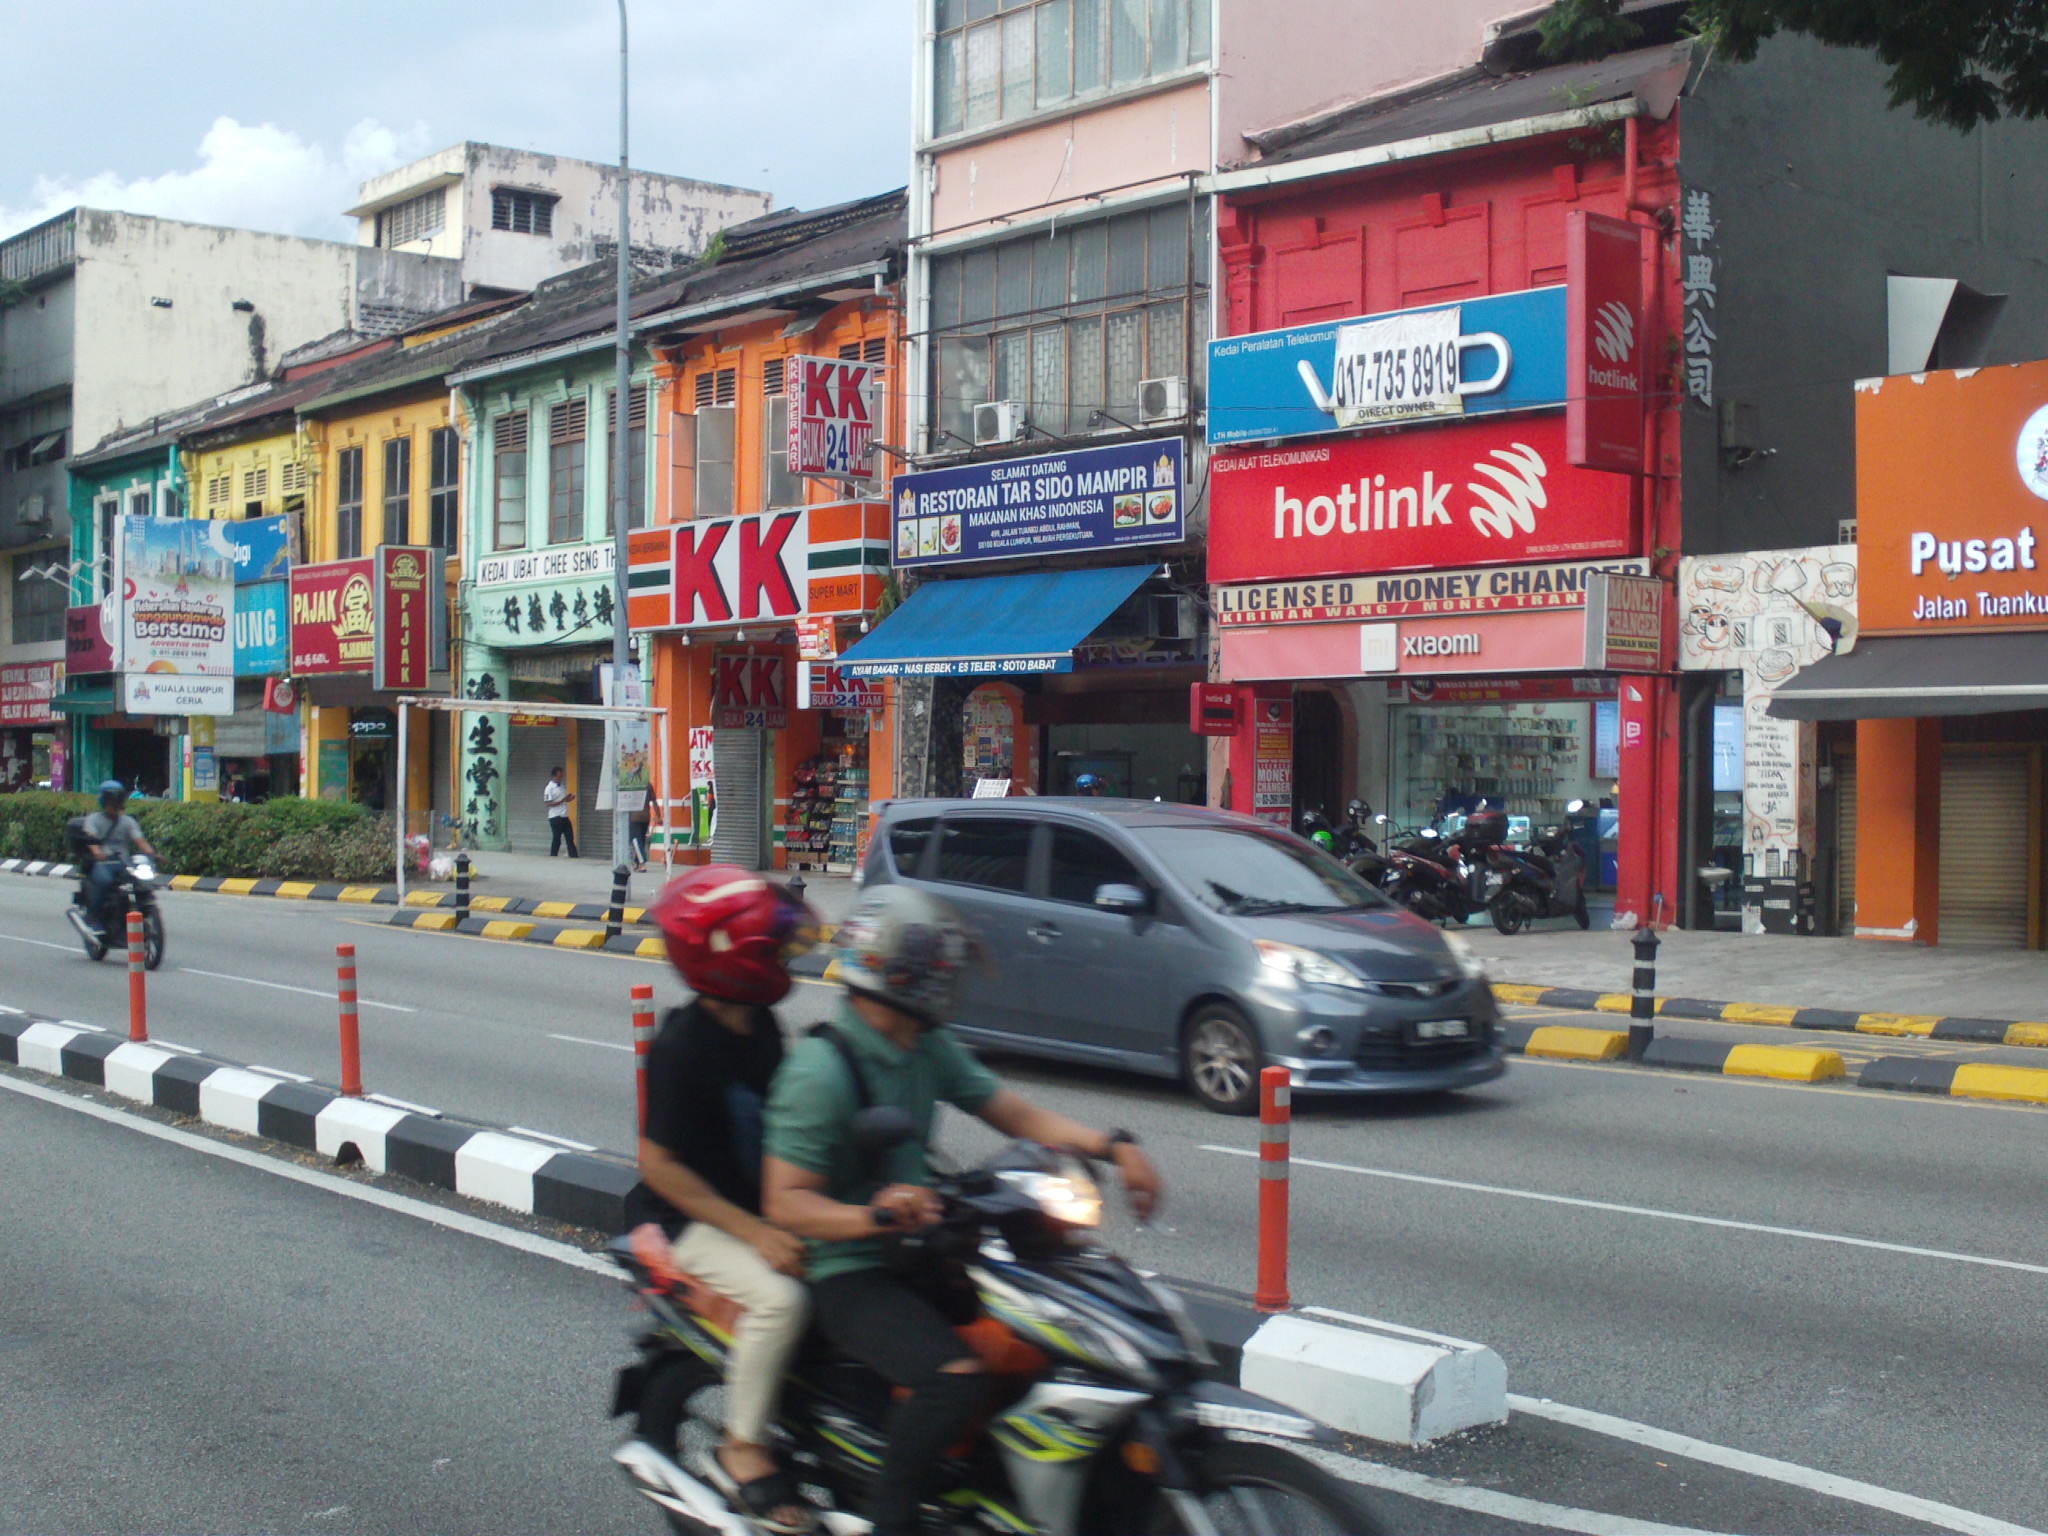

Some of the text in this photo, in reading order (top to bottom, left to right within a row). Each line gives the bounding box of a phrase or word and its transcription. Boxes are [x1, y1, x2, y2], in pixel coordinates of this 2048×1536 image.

[1213, 342, 1239, 358] Kedai
[1241, 338, 1284, 353] Peralatan
[790, 360, 799, 379] KK
[1412, 340, 1457, 398] 8919
[1588, 363, 1639, 392] hotlink
[806, 360, 868, 421] KK
[790, 383, 799, 429] SUPER
[1358, 401, 1436, 419] DIRECT OWNER
[790, 433, 799, 471] MART
[802, 421, 825, 468] BUKA
[826, 423, 849, 472] 24
[1213, 448, 1330, 473] KEDAI ALAT TELEKOMUNIKASI
[991, 459, 1067, 481] SELAMAT DATANG
[920, 465, 1148, 515] RESTORAN TAR SIDO MAMPIR
[969, 498, 1104, 528] MAKANAN KHAS INDONESIA
[1275, 471, 1453, 539] hotlink
[1911, 525, 2036, 575] Pusat
[482, 558, 509, 583] KEDAI
[513, 557, 539, 579] UBAT
[543, 553, 568, 576] CHEE
[573, 549, 599, 572] SENG
[675, 510, 802, 625] KK
[809, 583, 859, 599] SUPER MART
[1223, 582, 1354, 612] LICENSED
[1377, 574, 1482, 603] MONEY
[1608, 577, 1660, 613] MONEY
[1913, 590, 2048, 620] Jalan Tuanku
[293, 589, 338, 625] PAJAK
[1222, 608, 1313, 623] KIRIMAN
[1326, 604, 1388, 617] WANG
[1422, 597, 1502, 612] MONEY
[135, 621, 225, 642] Bersama
[400, 592, 411, 683] PAJAK
[1607, 610, 1659, 637] CHANGER
[720, 657, 780, 707] KK
[852, 659, 1057, 677] AYAM BAKAR NASI BEBEK ES TELER SOTO BABAT
[154, 684, 224, 694] KUALA LUMPUR
[176, 696, 203, 705] CERIA
[811, 693, 882, 707] BUKA 24 JAM
[745, 711, 765, 727] 24
[690, 730, 714, 749] ATM
[1257, 768, 1291, 782] MONEY
